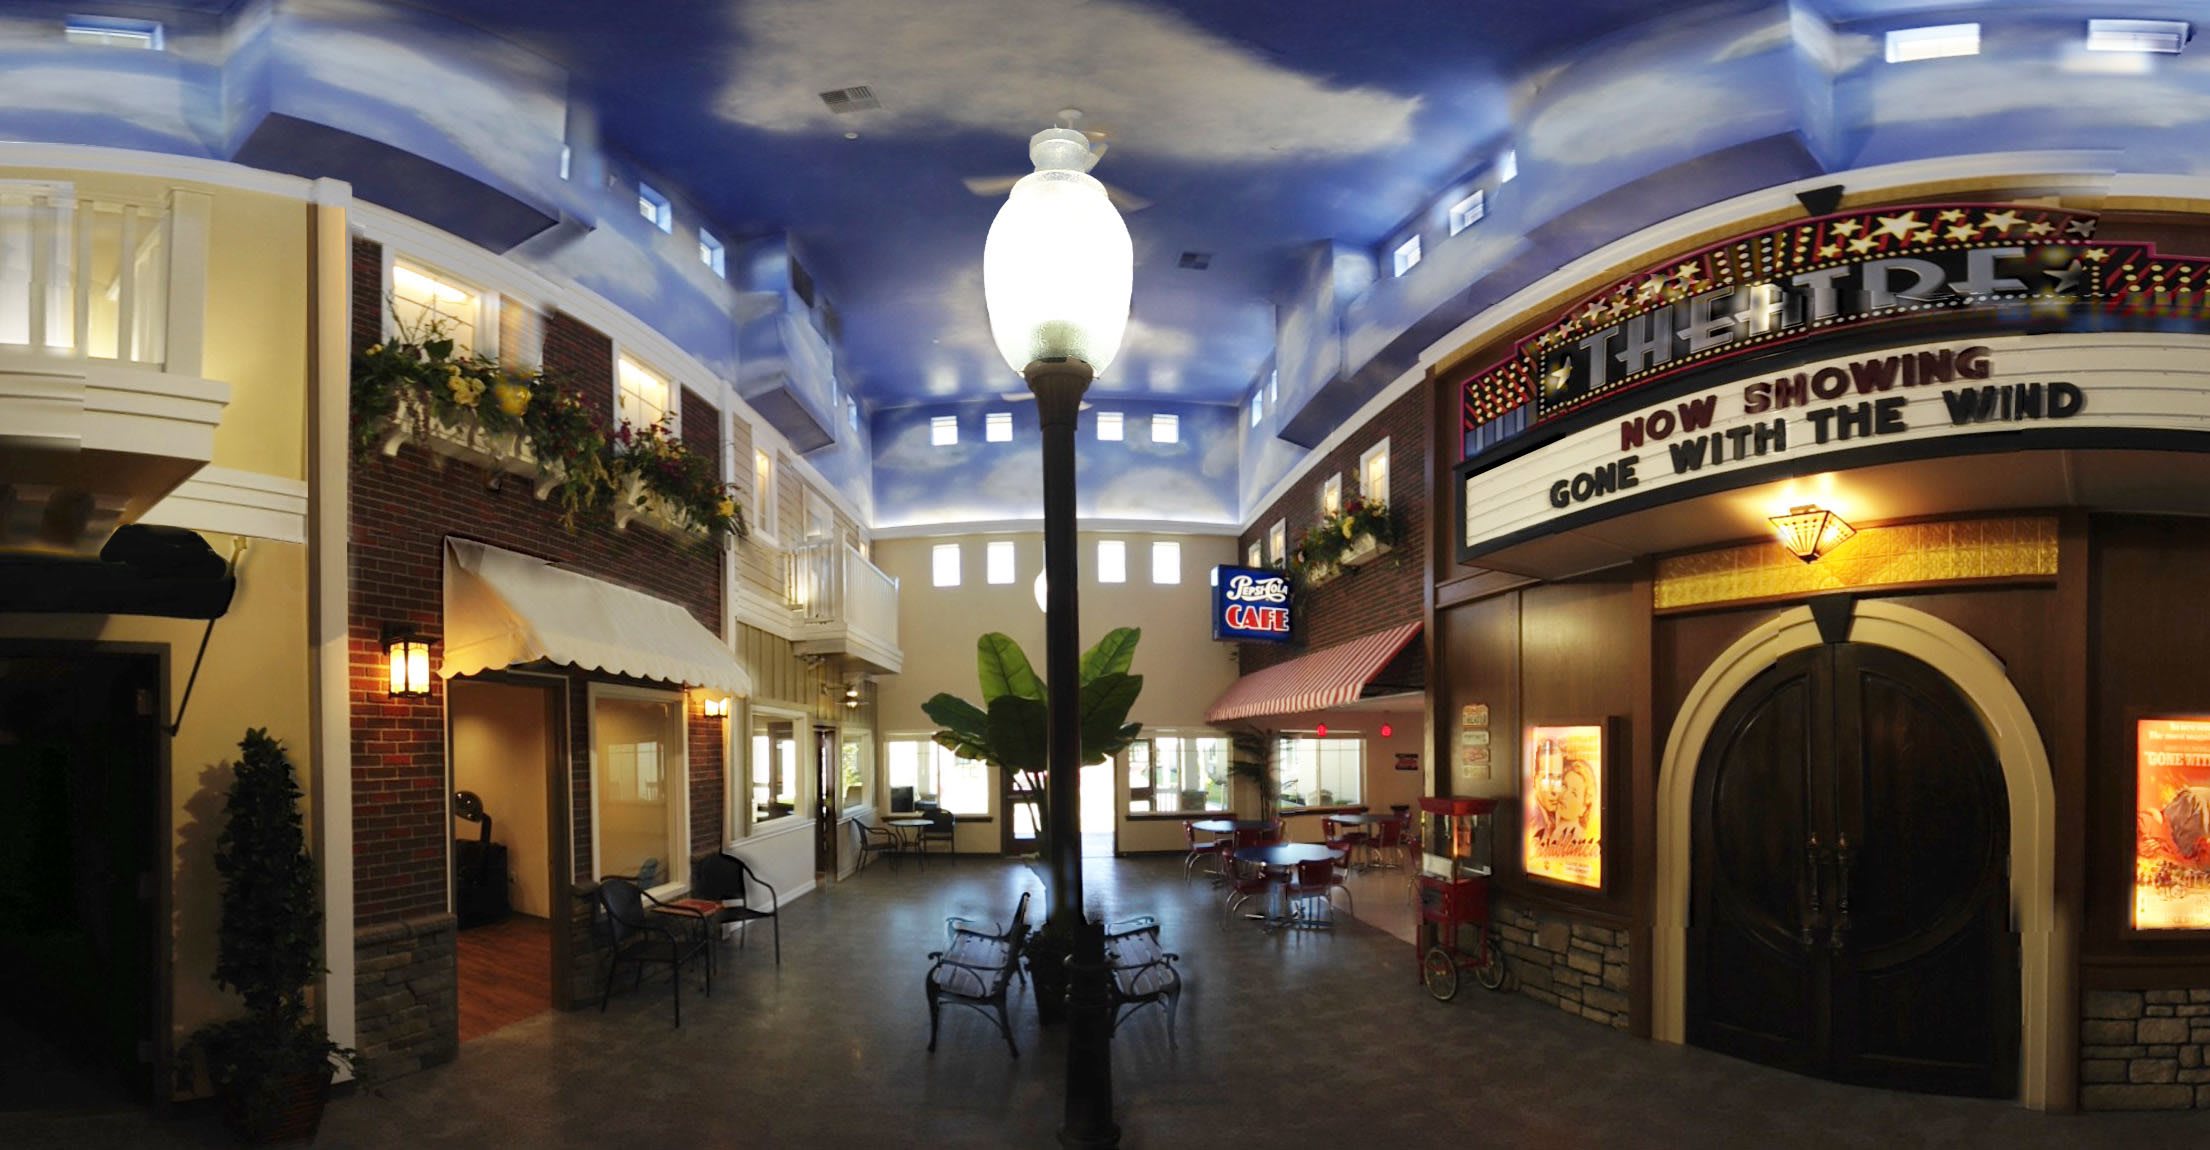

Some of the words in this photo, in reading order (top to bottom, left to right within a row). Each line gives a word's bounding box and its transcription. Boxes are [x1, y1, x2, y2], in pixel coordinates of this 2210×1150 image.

[1579, 246, 2026, 390] THEATRE
[1550, 455, 1640, 508] GONE
[1668, 418, 1787, 475] WITH
[1806, 396, 1908, 445] THE
[1942, 381, 2087, 427] WIND
[1620, 395, 1718, 450] NOW
[1743, 346, 1992, 415] SHOWING
[1225, 604, 1290, 632] CAFE
